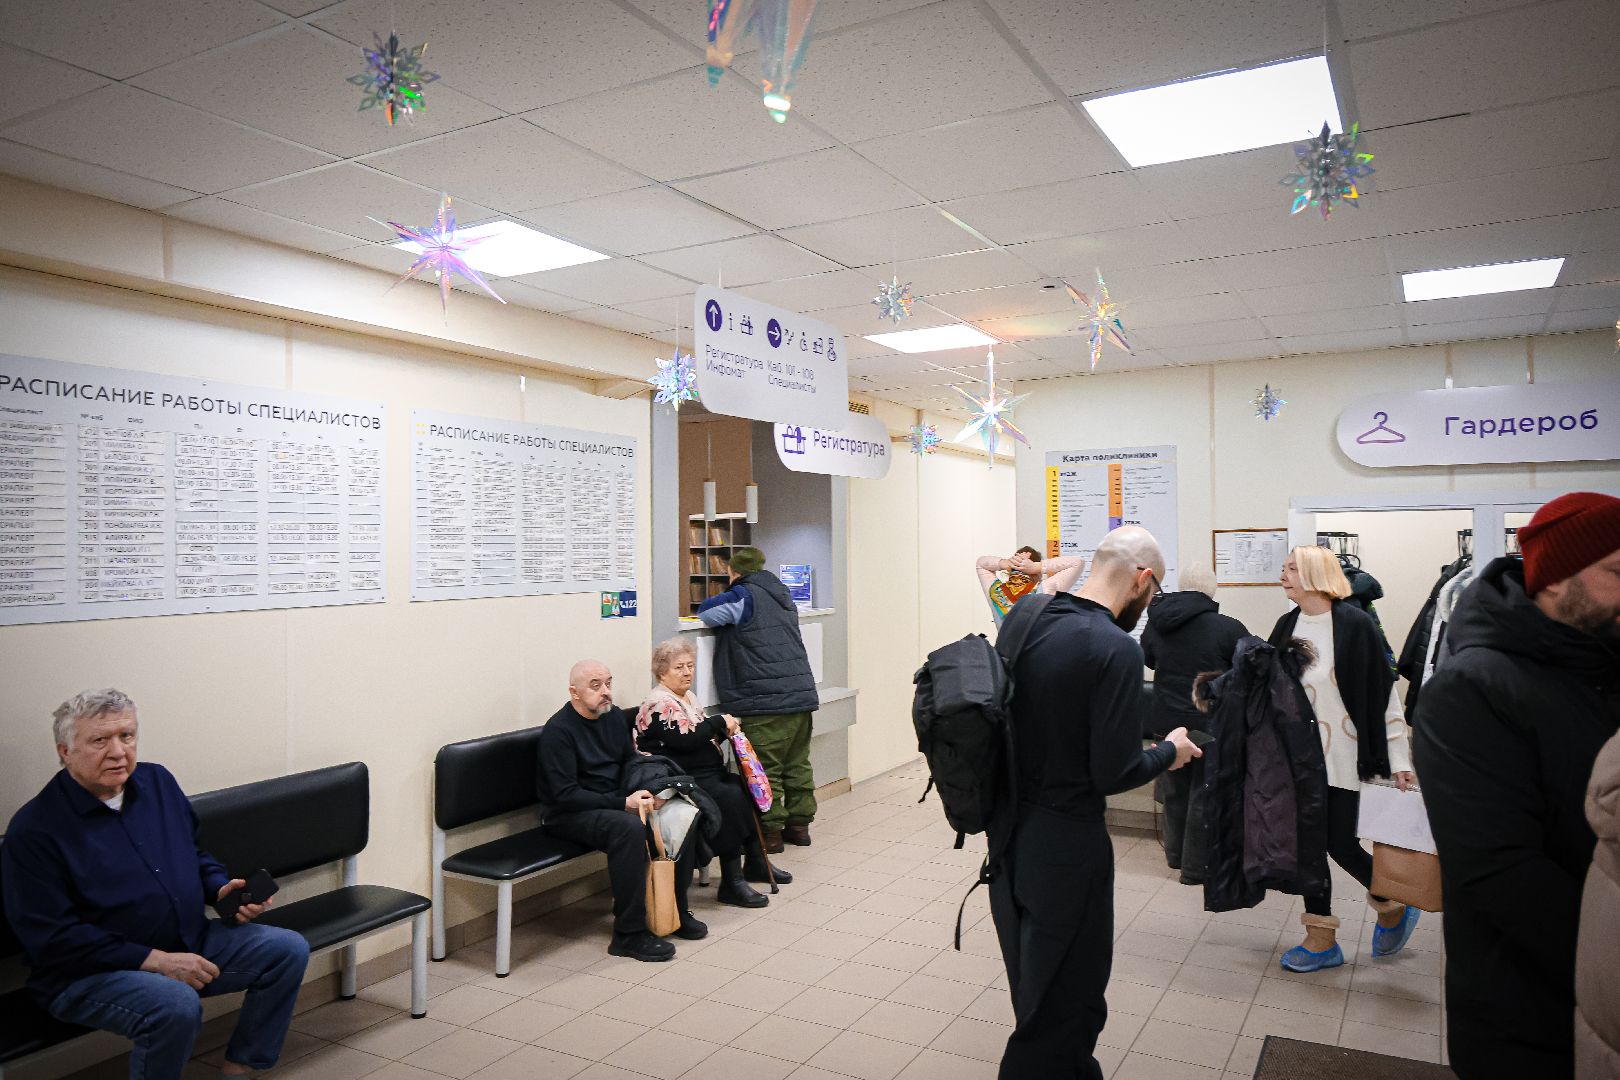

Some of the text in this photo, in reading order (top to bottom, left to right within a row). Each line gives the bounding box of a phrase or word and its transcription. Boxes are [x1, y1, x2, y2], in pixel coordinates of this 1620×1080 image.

[705, 344, 764, 370] Регистратура
[705, 358, 746, 379] Инфомат
[768, 374, 817, 394] Специалисты
[0, 374, 382, 430] РАСПИСАНИЕ РАБОТЫ СПЕЦИАЛИСТОВ
[1445, 408, 1599, 438] Гардероб
[430, 424, 635, 458] РАСПИСАНИЕ РАБОТЫ СПЕЦИАЛИСТОВ
[813, 430, 885, 457] Регистратура
[1062, 452, 1158, 464] Карта поликлиники
